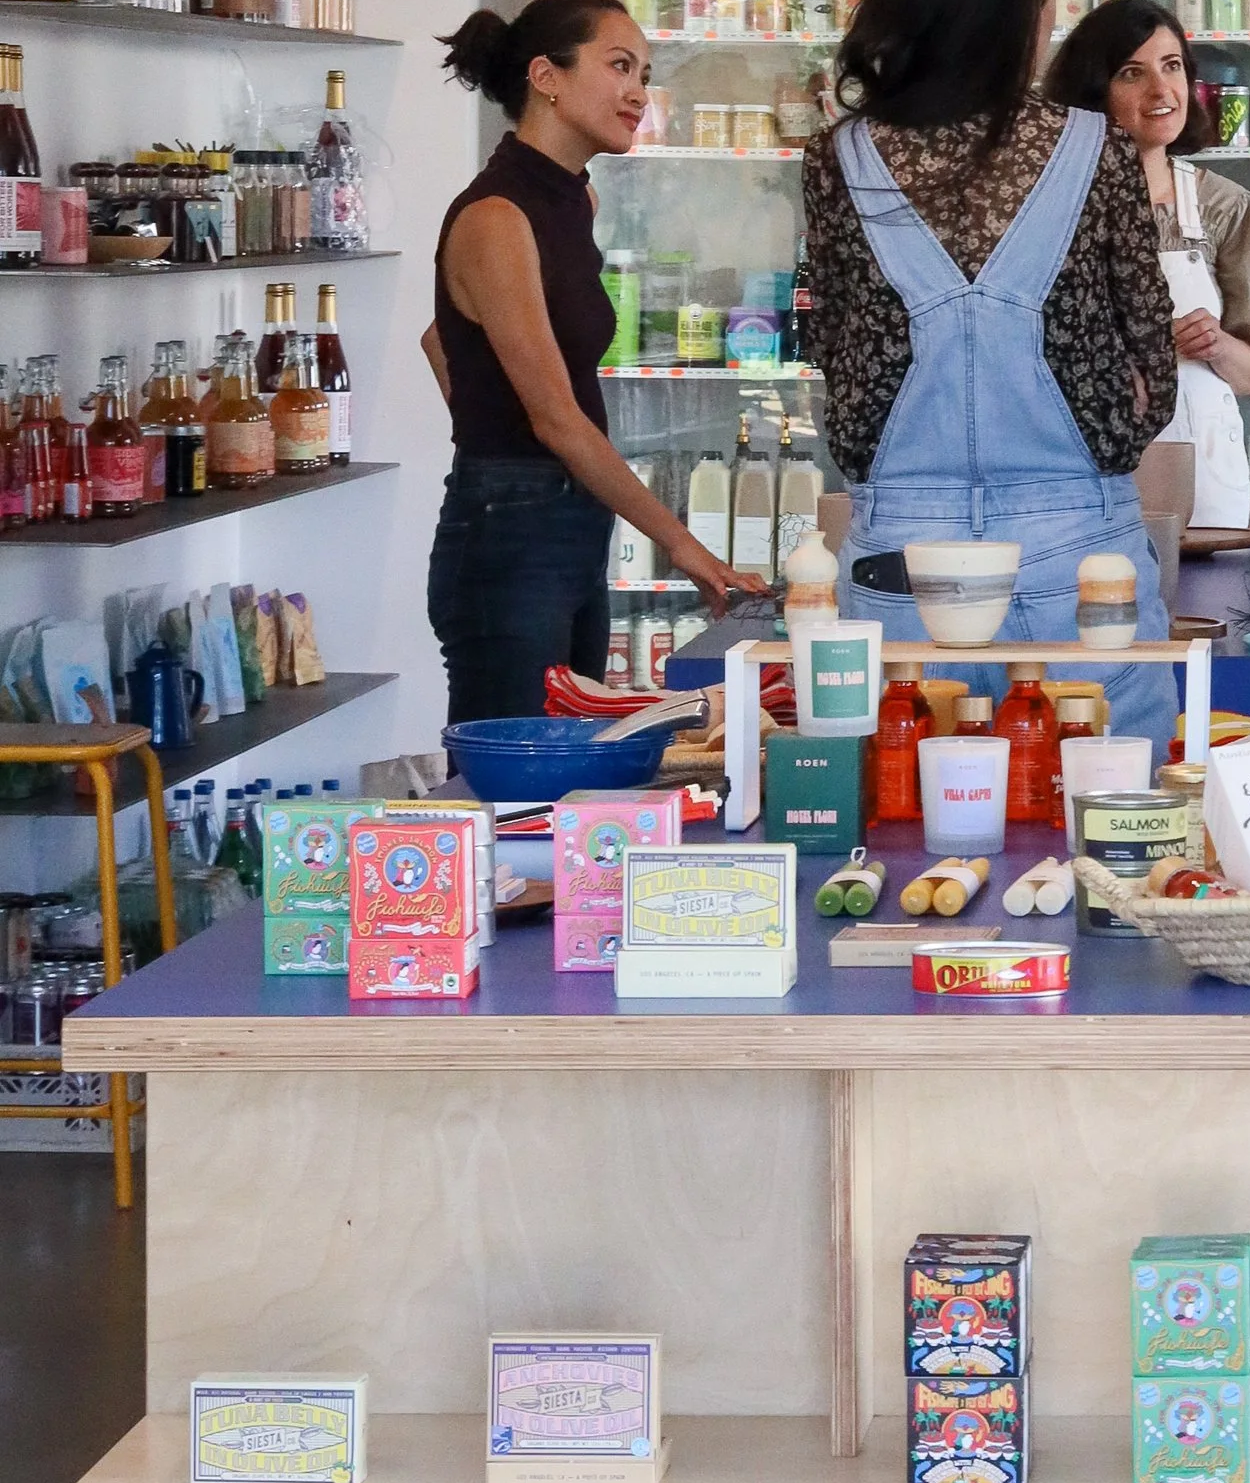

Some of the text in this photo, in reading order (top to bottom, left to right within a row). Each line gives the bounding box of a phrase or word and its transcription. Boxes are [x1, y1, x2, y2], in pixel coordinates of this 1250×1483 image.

[795, 759, 828, 767] ROEN
[1110, 817, 1170, 831] SALMON
[634, 869, 700, 896] TUNA
[679, 896, 715, 915] SIESTA
[504, 1363, 639, 1388] ANCHOVIES
[543, 1390, 582, 1410] SIESTA
[200, 1404, 346, 1434] TUNA BELLY
[529, 1417, 600, 1435] OLIVE
[246, 1432, 282, 1450] SIESTA
[205, 1444, 227, 1466] IN
[232, 1454, 301, 1473] OLIVE
